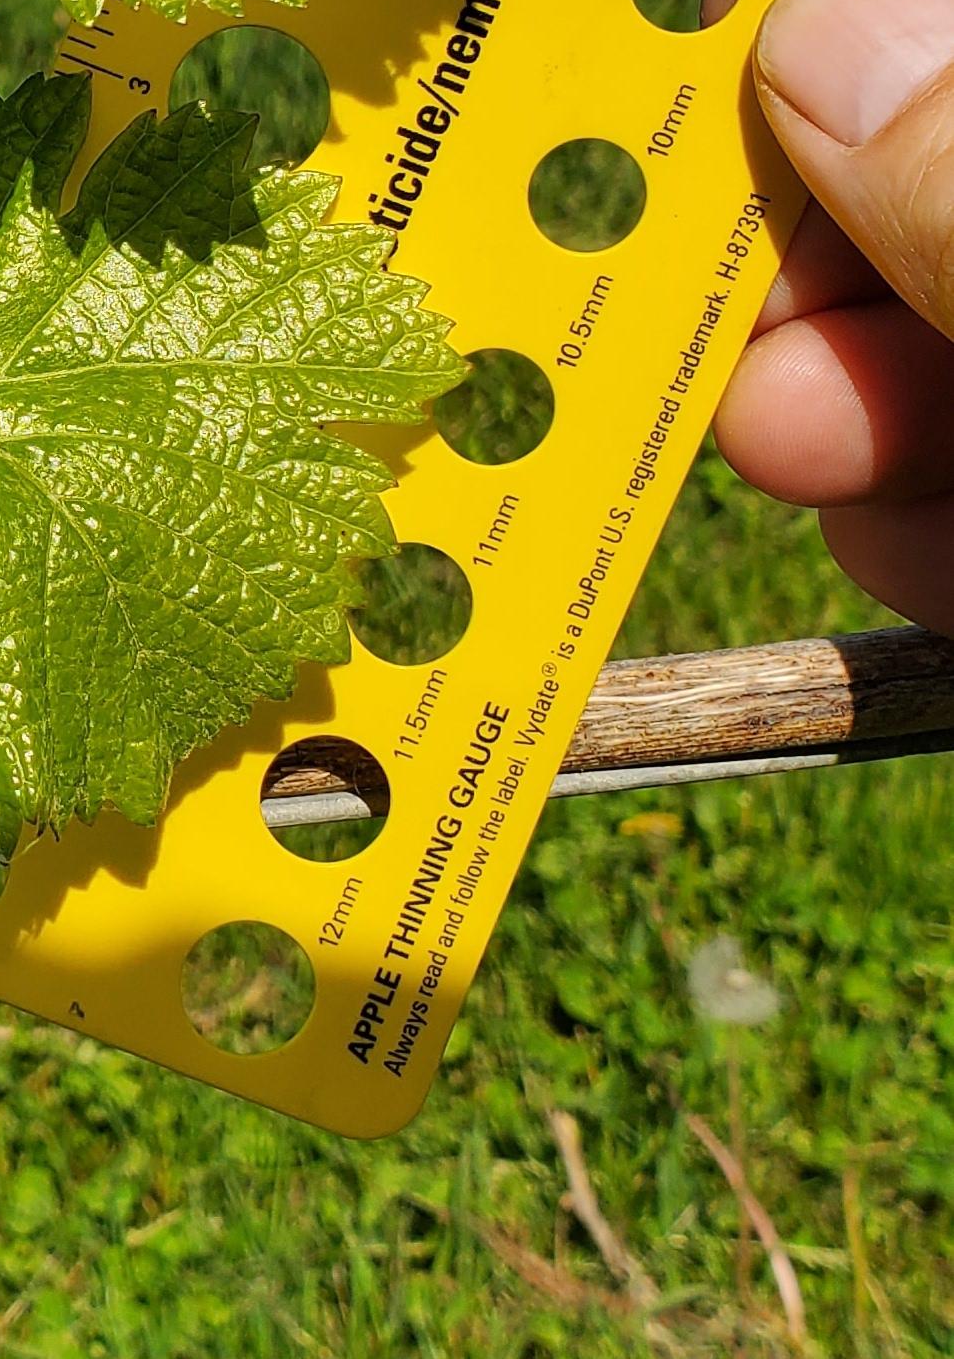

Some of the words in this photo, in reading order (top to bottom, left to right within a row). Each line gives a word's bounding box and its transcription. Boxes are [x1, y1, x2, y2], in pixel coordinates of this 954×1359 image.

[129, 77, 150, 94] 3
[648, 85, 696, 156] 10mm
[716, 193, 772, 280] H-87391
[557, 276, 613, 367] 10.5mm
[669, 290, 730, 393] trademark.
[626, 397, 680, 498] registered
[473, 496, 519, 565] 11mm
[600, 508, 634, 543] U.S.
[568, 548, 614, 619] DuPont
[551, 643, 574, 660] is
[567, 625, 582, 637] a
[394, 668, 446, 758] 11.5mm
[491, 759, 526, 805] label.
[479, 811, 504, 841] the
[348, 967, 402, 1064] APPLE
[384, 816, 462, 959] THINNING
[449, 702, 509, 808] GAUGE
[450, 846, 489, 905] follow
[319, 878, 362, 945] 12mm
[439, 909, 464, 947] and
[418, 951, 447, 998] read
[384, 1001, 428, 1077] Always
